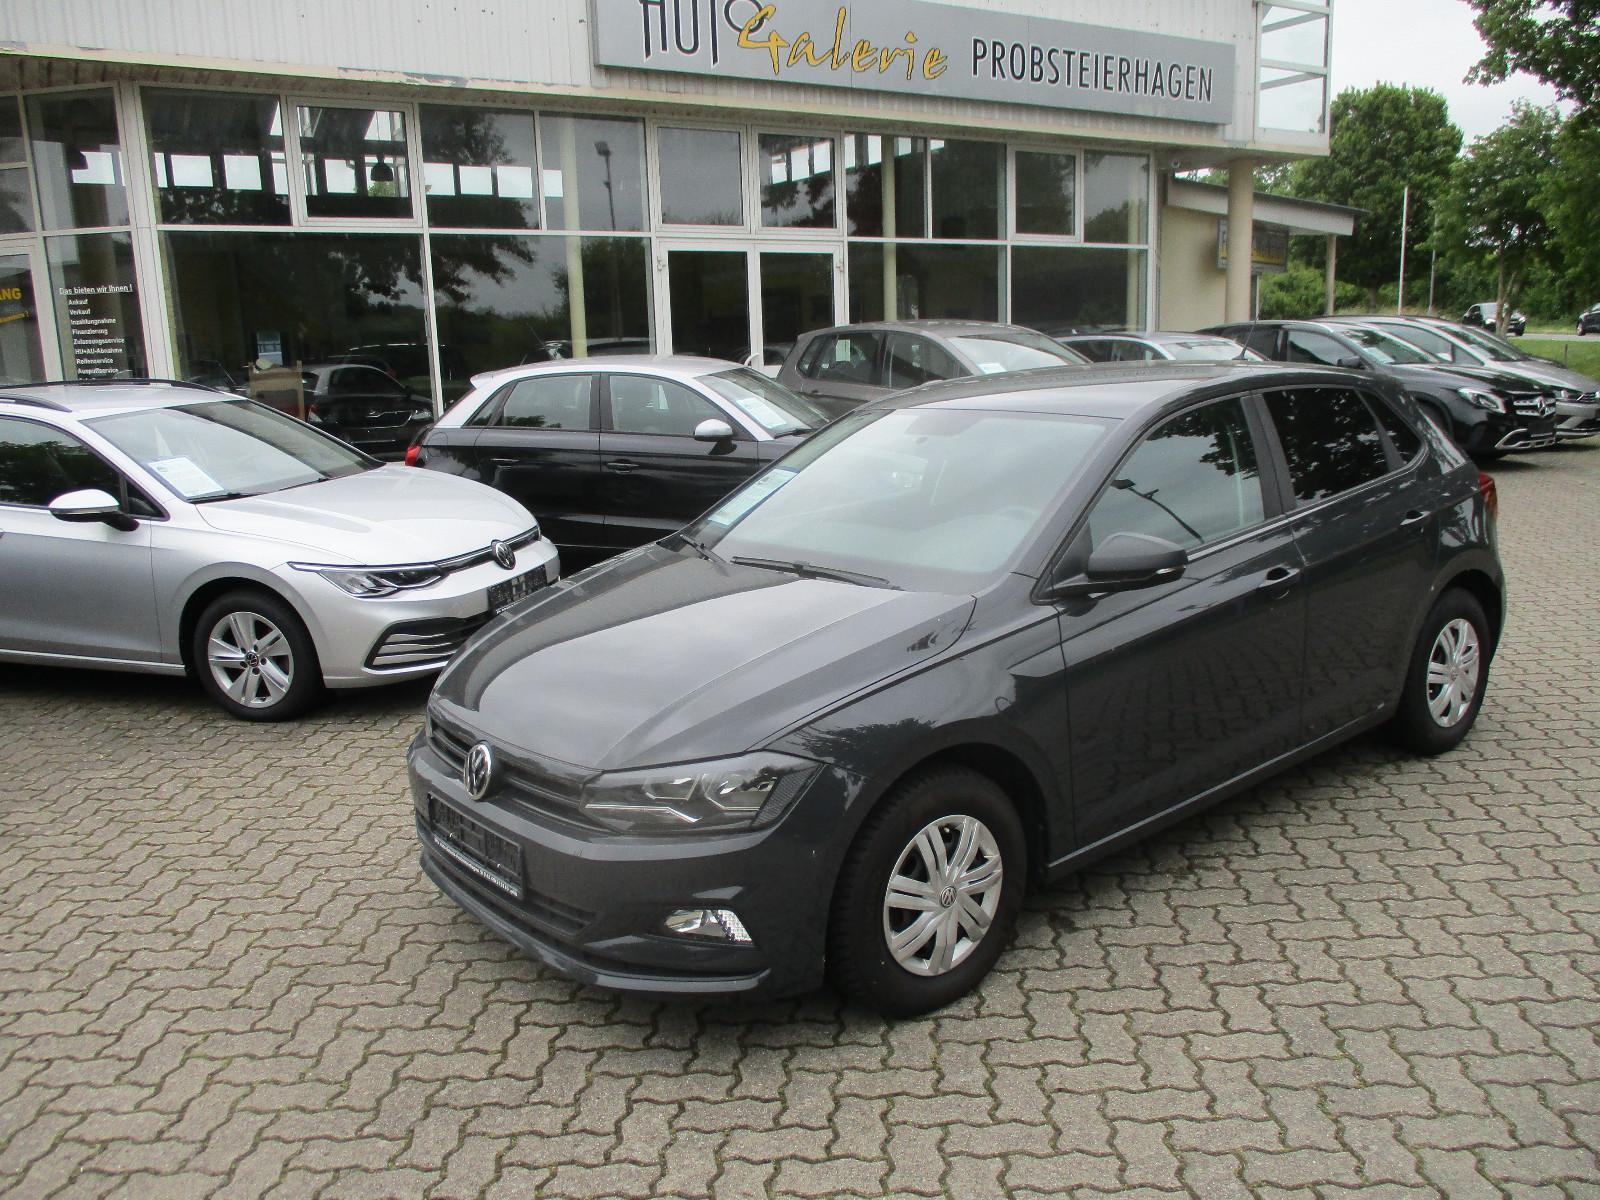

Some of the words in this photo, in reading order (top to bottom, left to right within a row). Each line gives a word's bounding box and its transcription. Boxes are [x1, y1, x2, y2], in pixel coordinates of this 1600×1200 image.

[737, 5, 948, 81] Galerie
[971, 36, 1213, 103] PROBSTEIERHAGEN
[59, 287, 73, 295] Das
[74, 286, 95, 294] bieten
[97, 285, 108, 293] wir
[108, 284, 129, 293] Ihnen
[68, 298, 88, 306] Ankauf
[73, 337, 125, 345] Zulassungsservice
[77, 367, 119, 375] Auspuffservice
